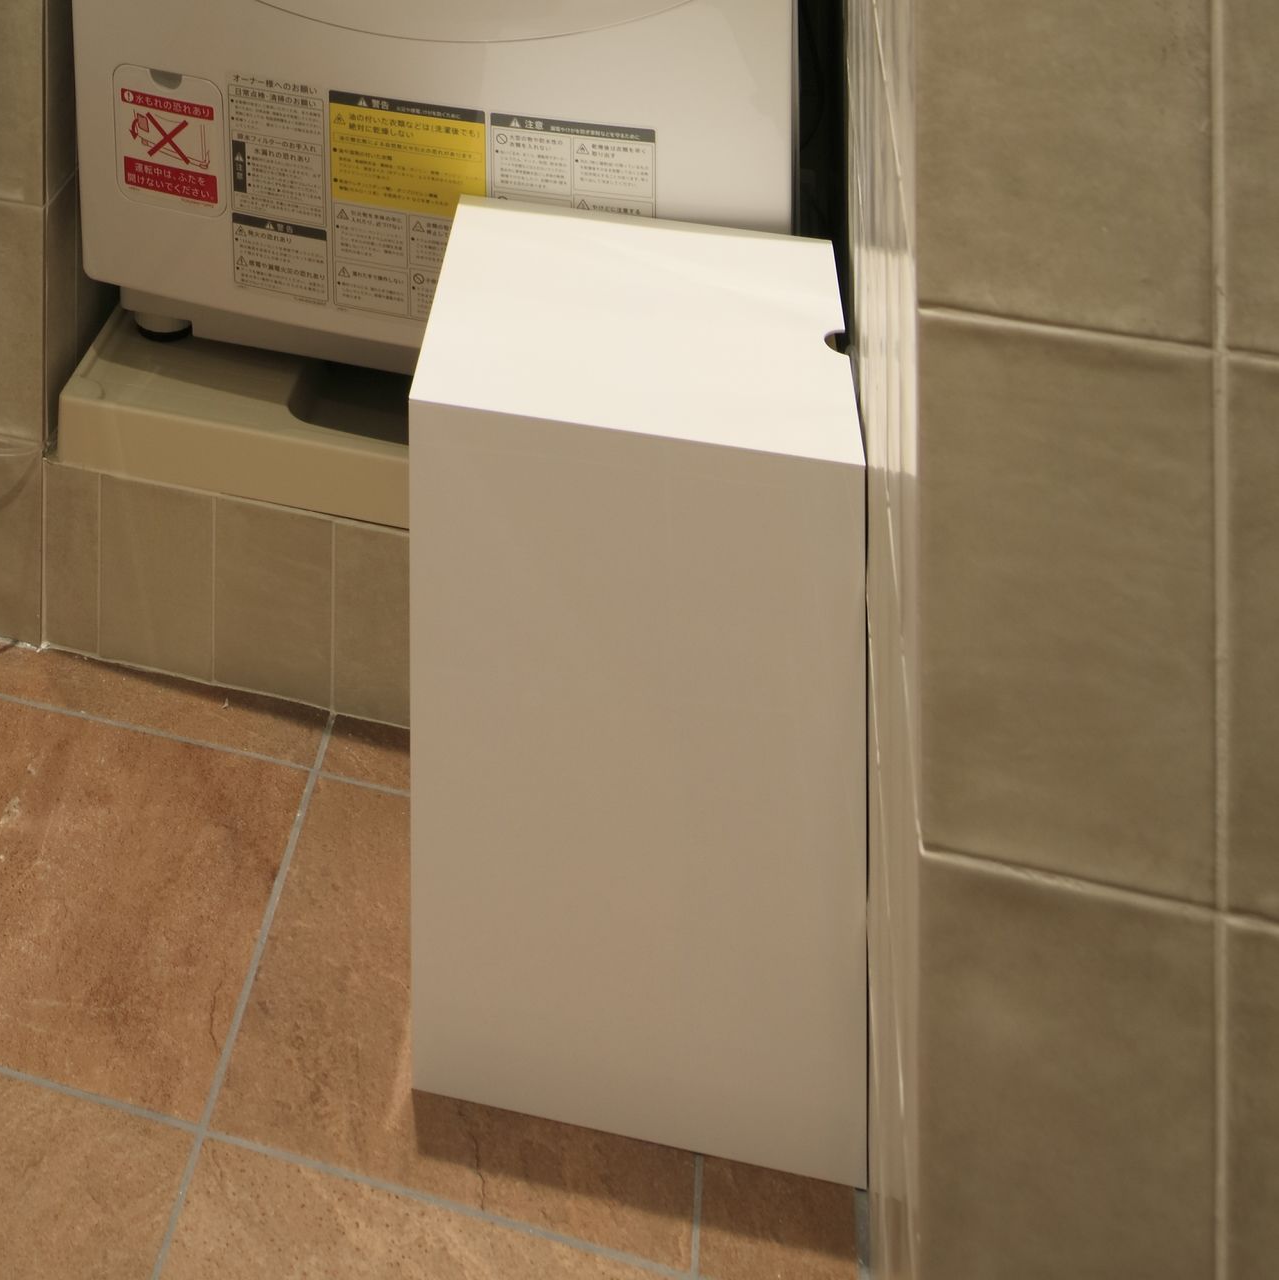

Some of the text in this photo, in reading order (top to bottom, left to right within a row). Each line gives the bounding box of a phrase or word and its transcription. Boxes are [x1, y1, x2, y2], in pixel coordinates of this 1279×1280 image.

[135, 94, 211, 119] 水もれの恐れあり
